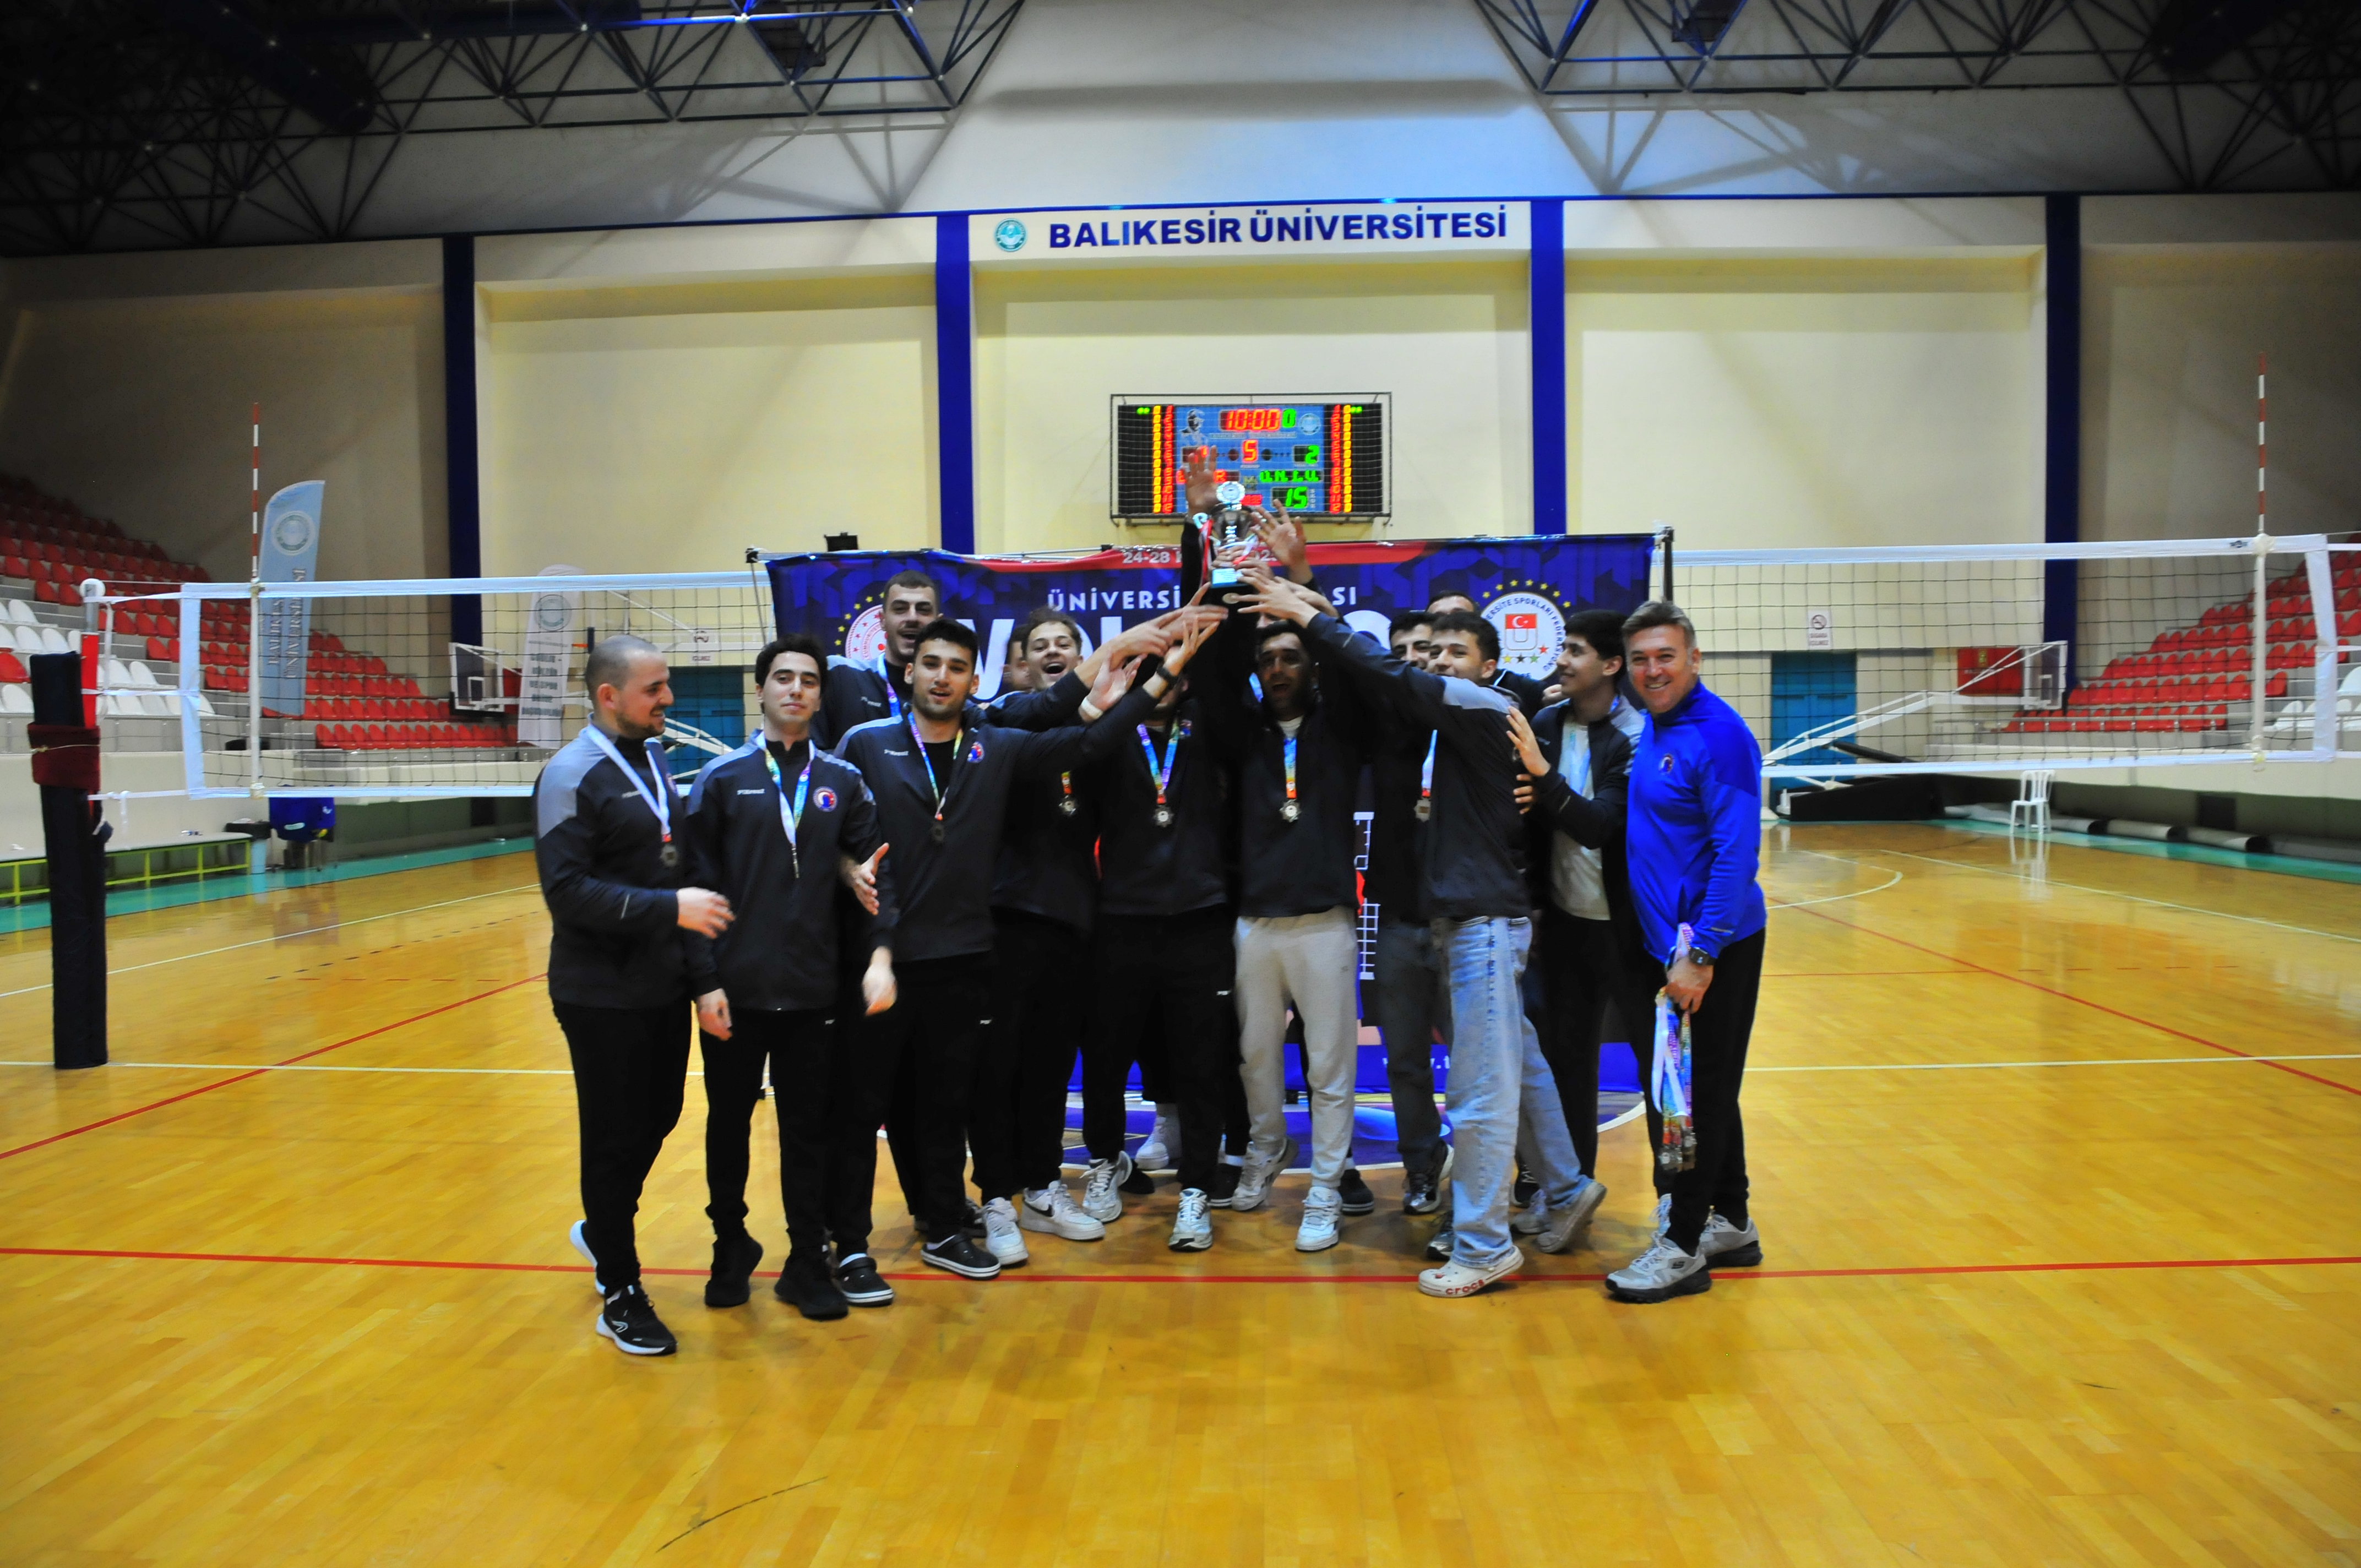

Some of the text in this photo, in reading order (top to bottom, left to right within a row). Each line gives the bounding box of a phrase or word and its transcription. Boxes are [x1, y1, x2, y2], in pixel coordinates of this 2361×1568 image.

[1049, 210, 1242, 248] BALIKESİR
[1250, 204, 1506, 242] ÜNİVERSİTESİ
[1226, 409, 1281, 431] 10:00
[1242, 439, 1258, 463] 5
[1304, 445, 1320, 464] 2
[1285, 486, 1308, 509] 15
[1122, 551, 1171, 564] 24-28
[1445, 1279, 1484, 1295] crocs
